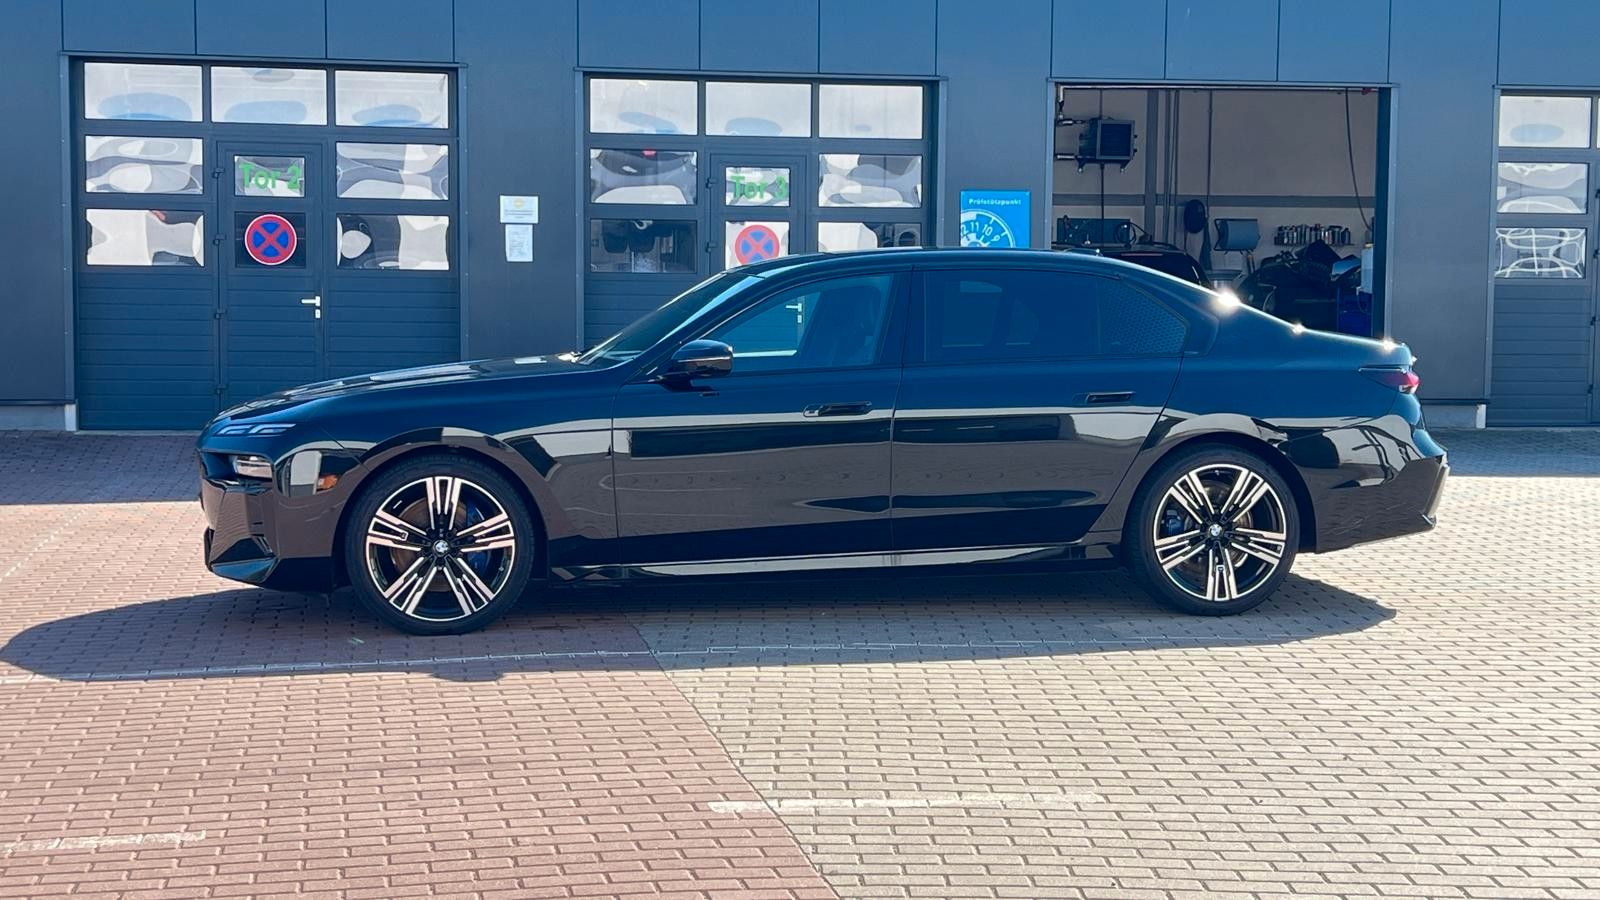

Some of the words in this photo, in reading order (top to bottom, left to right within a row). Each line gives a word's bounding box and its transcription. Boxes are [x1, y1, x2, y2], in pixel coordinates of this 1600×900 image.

[239, 163, 282, 189] Tor
[287, 165, 301, 190] 2
[730, 175, 769, 199] Tor
[775, 175, 788, 199] 3
